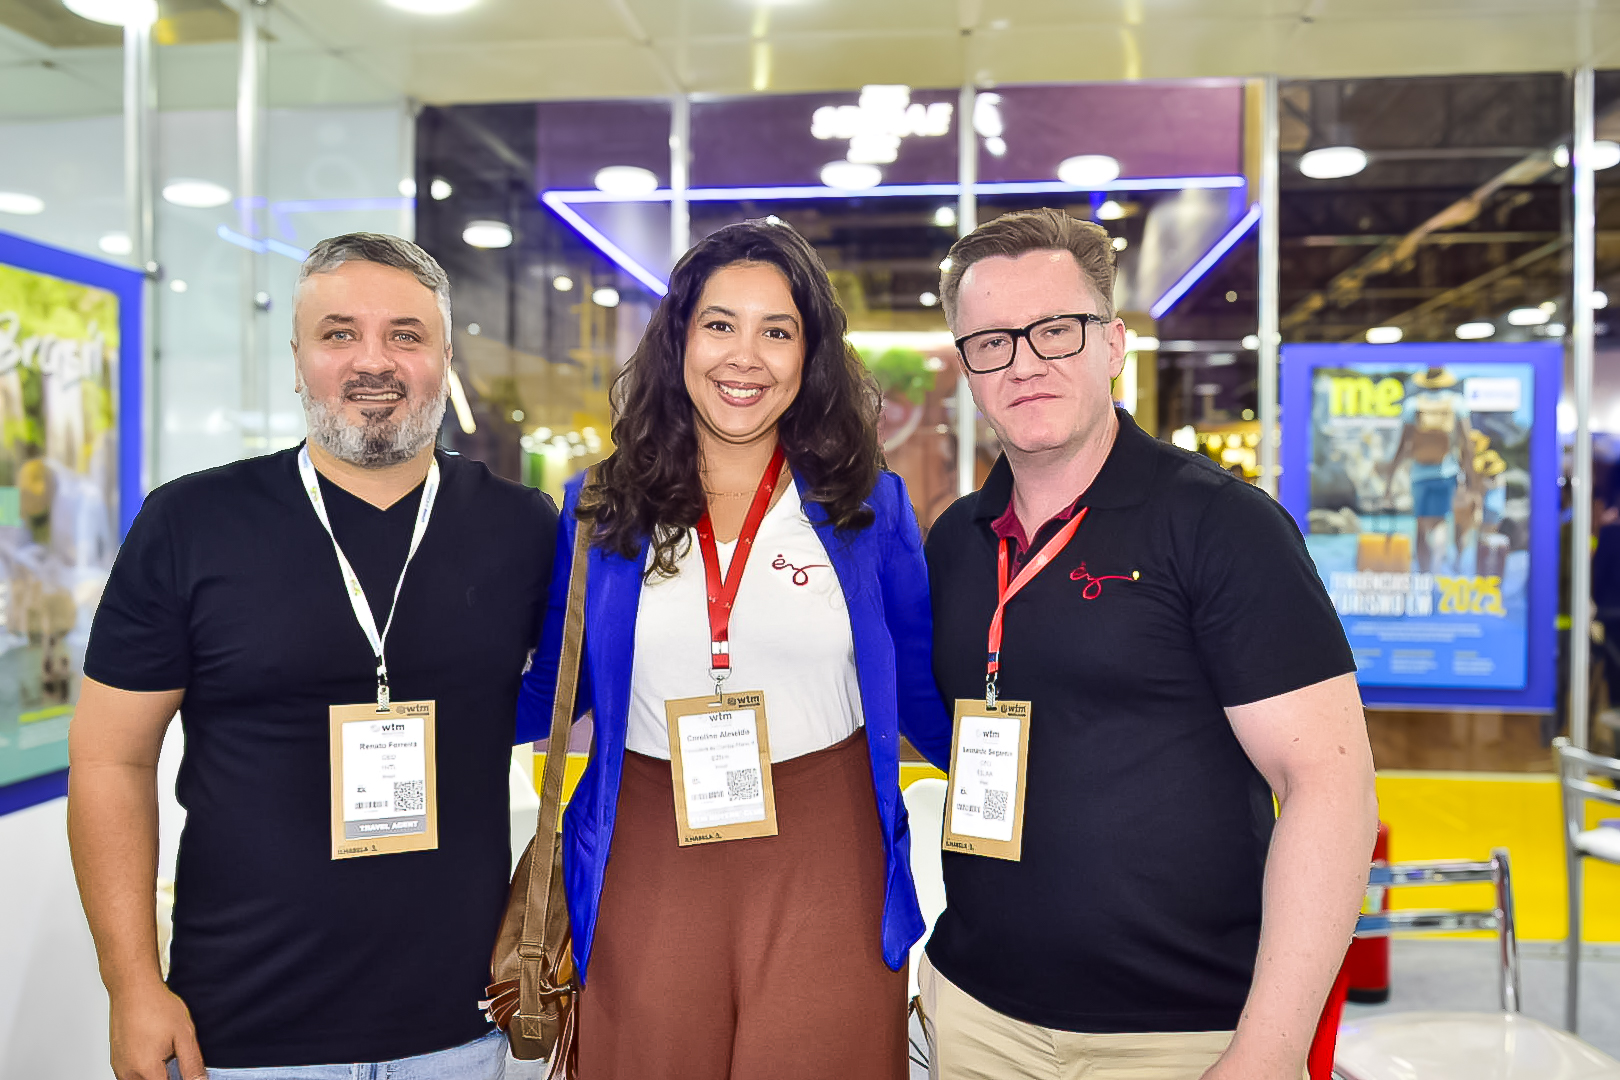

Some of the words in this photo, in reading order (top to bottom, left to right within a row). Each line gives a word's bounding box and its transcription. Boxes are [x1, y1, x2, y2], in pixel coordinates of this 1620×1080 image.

[1330, 376, 1404, 417] me
[737, 695, 760, 704] wtm
[405, 704, 430, 713] wtm
[1008, 704, 1027, 713] wtm
[709, 712, 732, 722] wtm
[381, 723, 405, 731] wtm
[983, 730, 1000, 738] wtm
[359, 823, 391, 832] TRAVEL
[391, 820, 419, 830] AGENT
